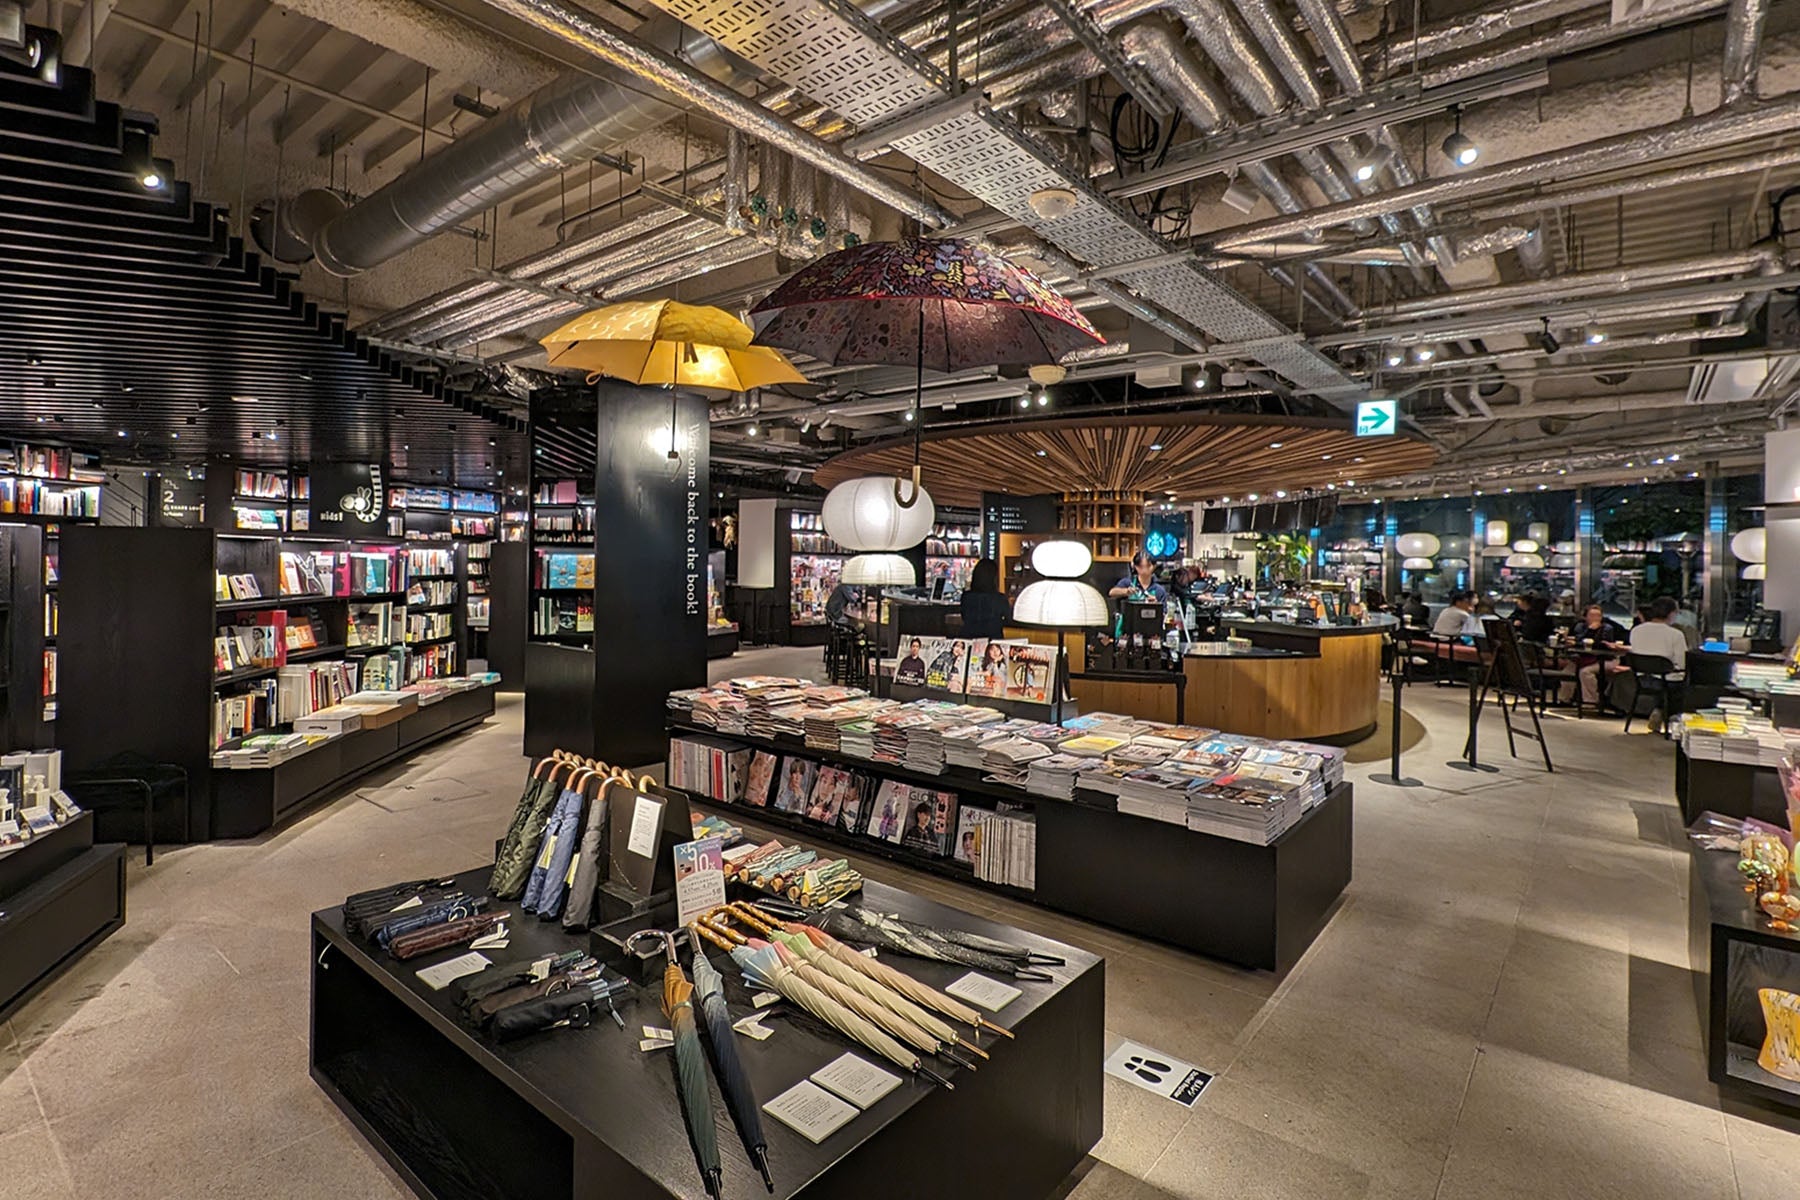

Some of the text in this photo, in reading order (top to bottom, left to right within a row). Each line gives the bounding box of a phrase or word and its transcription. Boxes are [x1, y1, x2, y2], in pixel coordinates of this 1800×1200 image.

[163, 490, 175, 503] 2
[687, 492, 700, 525] back
[687, 528, 696, 544] to
[687, 547, 699, 570] the
[686, 574, 699, 615] book!
